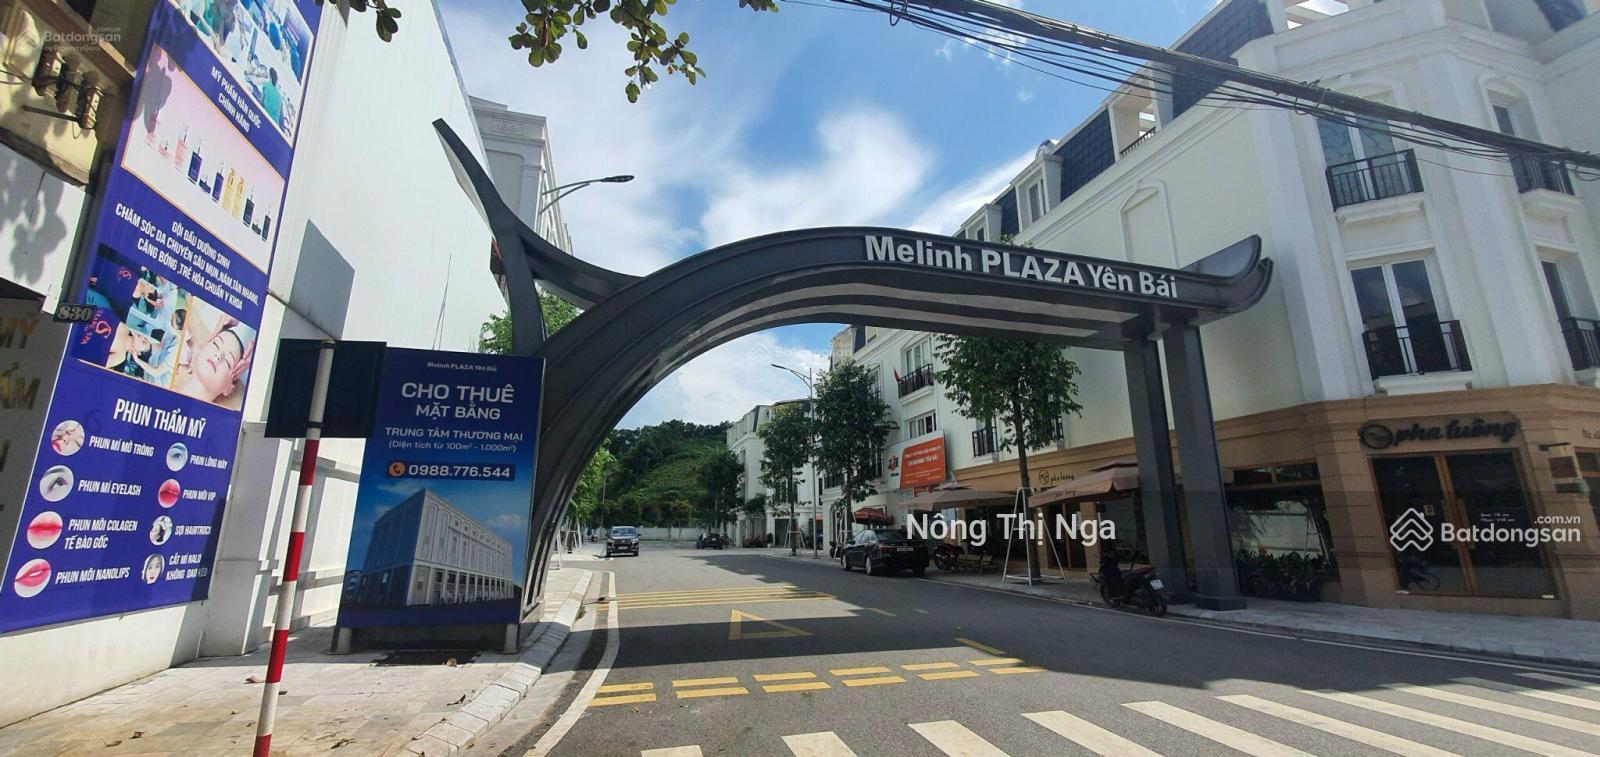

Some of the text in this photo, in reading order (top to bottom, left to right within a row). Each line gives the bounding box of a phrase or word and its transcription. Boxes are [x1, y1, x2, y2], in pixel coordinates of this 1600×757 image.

[115, 203, 141, 228] CHĂM
[140, 219, 156, 238] SÓC
[155, 229, 167, 245] DA
[166, 237, 194, 262] CHUYÊN
[192, 254, 206, 270] SÂU
[137, 237, 159, 259] CĂNG
[158, 250, 178, 271] BÓNG
[192, 271, 205, 288] HÓA
[204, 279, 225, 299] CHUẨN
[224, 290, 230, 302] Y
[228, 293, 243, 310] KHOA
[864, 234, 1179, 299] Melinh PLAZA Yên Bái
[58, 305, 92, 321] 830
[450, 363, 474, 371] PLAZA
[401, 382, 515, 403] CHO THUÊ
[113, 398, 207, 439] PHUN THẨM MỸ
[415, 401, 501, 421] MẶT BẰNG
[385, 427, 523, 443] TRUNG TÂM THƯƠNG MẠI
[1393, 423, 1443, 447] pha
[89, 435, 111, 450] PHUN
[110, 438, 122, 452] MÍ
[133, 443, 154, 457] TRÒNG
[388, 440, 412, 449] (Diện
[414, 440, 431, 449] tích
[433, 441, 444, 449] từ
[190, 454, 205, 466] PHUN
[204, 456, 218, 468] LÔNG
[408, 464, 511, 478] 0988.776.544
[78, 480, 142, 496] PHUN MÍ EYELASH
[183, 489, 216, 501] PHUN MÔI VIP
[68, 518, 138, 532] PHUN MÔI COLAGEN
[64, 534, 109, 550] TẾ BÀO GỐC
[169, 552, 181, 566] CẮT
[55, 567, 131, 585] PHUN MÔI NANOLIPS
[165, 568, 186, 581] KHÔNG
[185, 568, 198, 579] DAO
